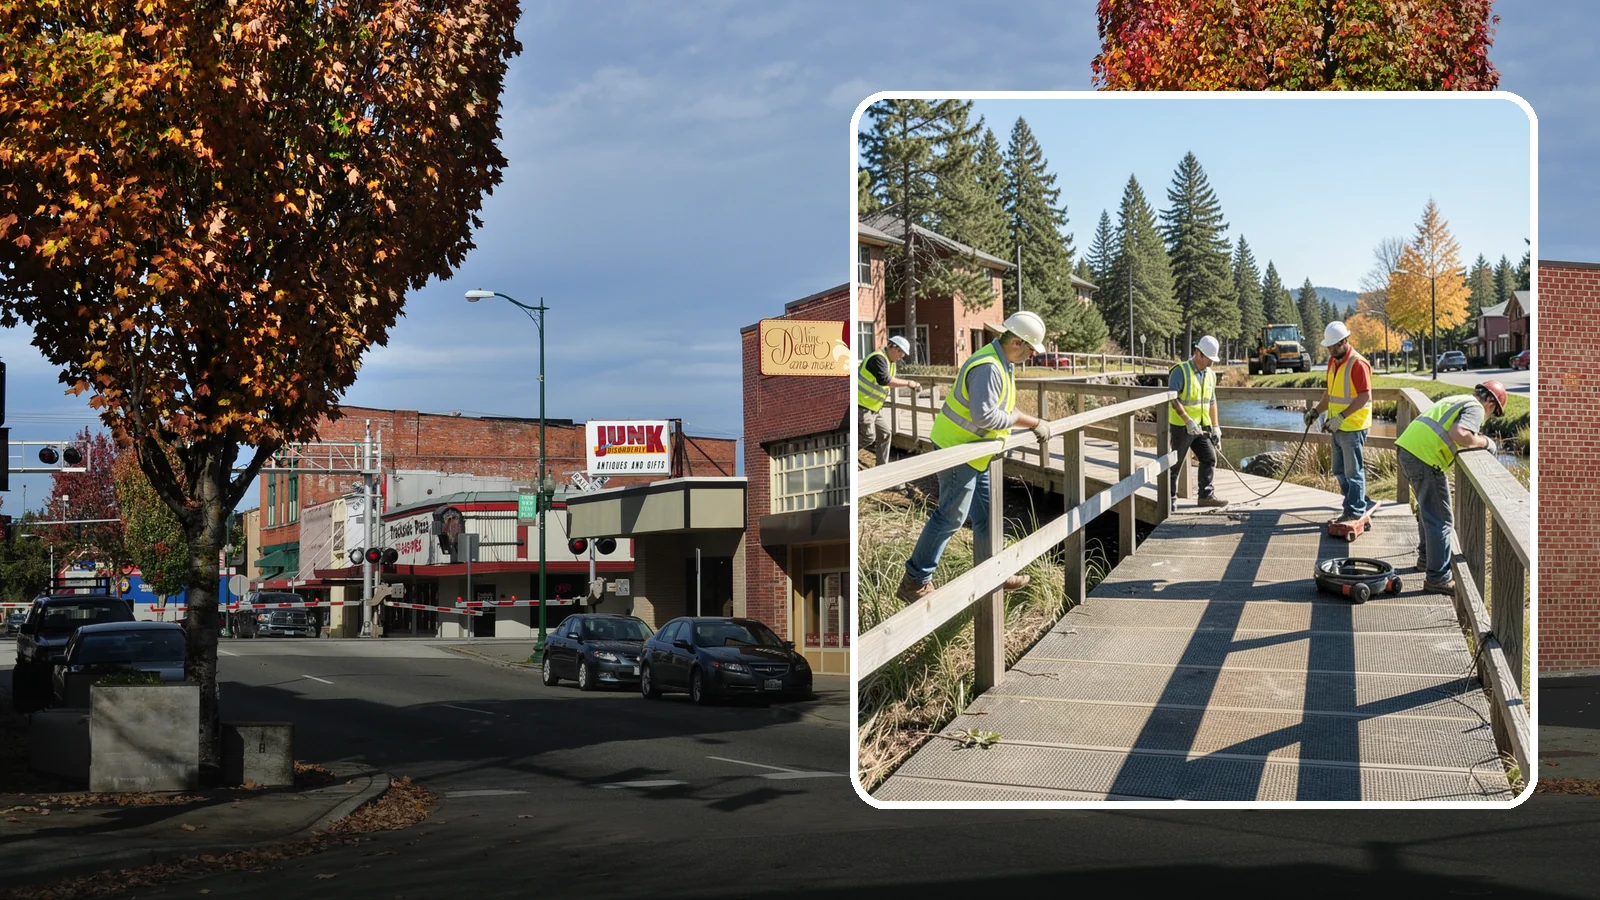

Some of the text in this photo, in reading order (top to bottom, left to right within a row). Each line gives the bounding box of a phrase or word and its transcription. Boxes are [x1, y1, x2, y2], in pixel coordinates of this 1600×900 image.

[595, 425, 665, 457] JUNK
[597, 461, 665, 470] ANTIQUES AND GIFTS
[415, 519, 429, 535] Pizza
